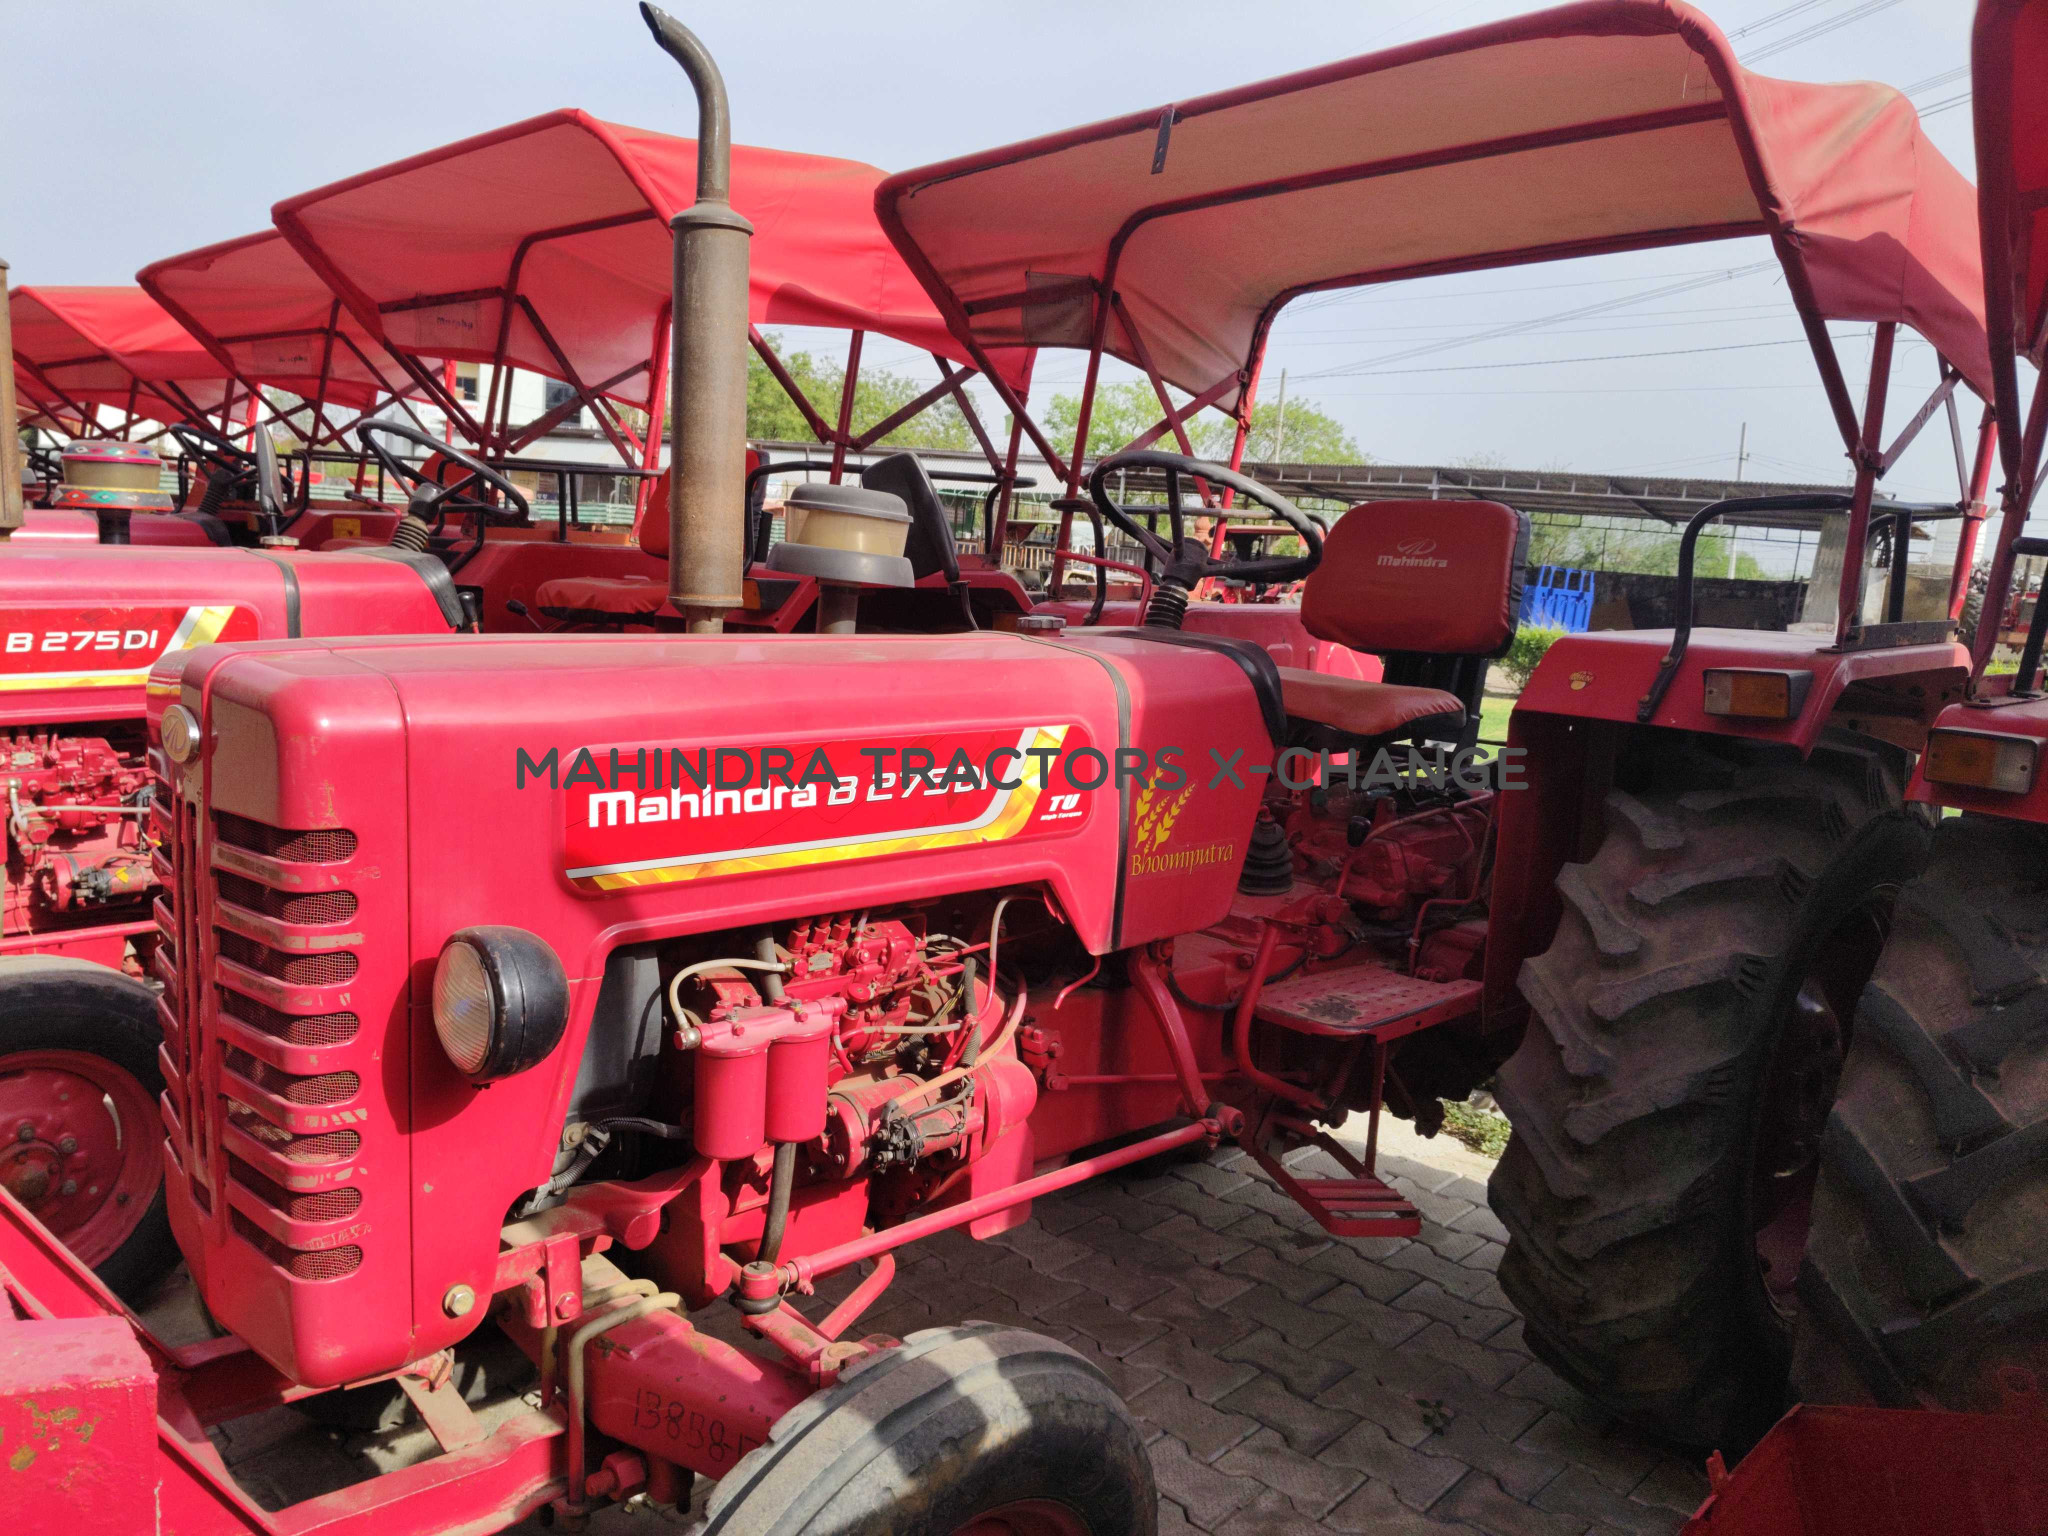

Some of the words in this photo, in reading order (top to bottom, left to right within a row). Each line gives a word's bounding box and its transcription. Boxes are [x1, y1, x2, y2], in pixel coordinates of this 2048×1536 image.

[5, 632, 34, 653] B
[41, 630, 158, 652] 275DI
[588, 780, 817, 828] Mahindra
[827, 775, 858, 806] B
[1049, 793, 1081, 812] TU
[1130, 844, 1233, 876] Bhoomiputra
